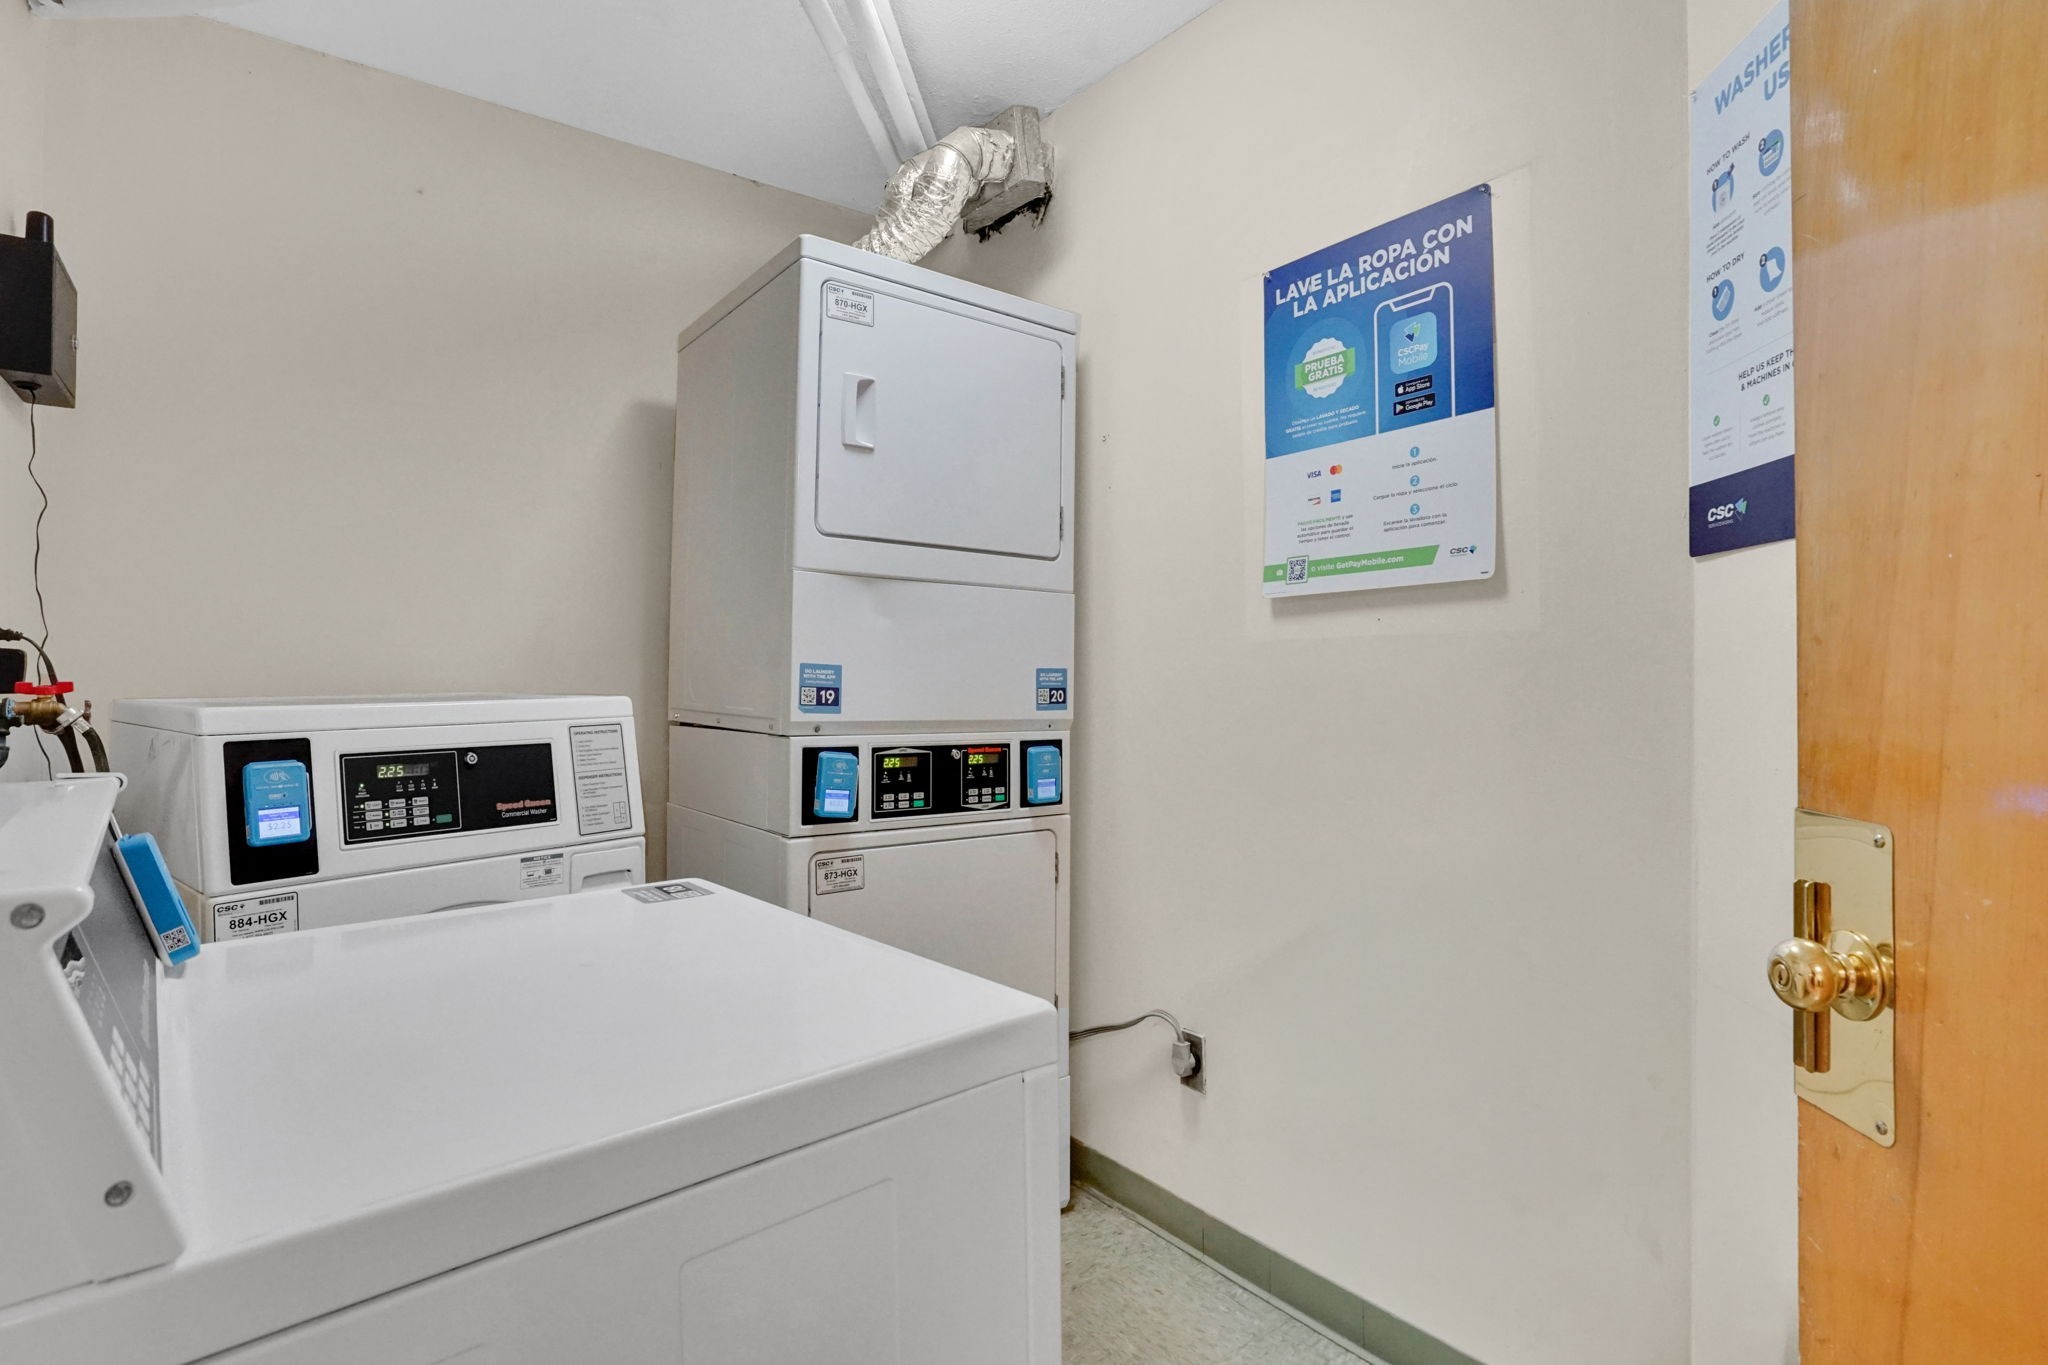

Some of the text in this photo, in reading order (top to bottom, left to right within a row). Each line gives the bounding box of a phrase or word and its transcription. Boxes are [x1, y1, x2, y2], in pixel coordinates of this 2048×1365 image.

[1706, 132, 1750, 175] HOW TO WASH
[1275, 214, 1473, 306] LAVE LA ROPA CON
[1706, 252, 1745, 283] HOW TO DRY
[1293, 245, 1450, 318] LA APLICACIÓN
[834, 298, 868, 313] 870-HGX
[1397, 343, 1429, 357] CSCPay
[1304, 353, 1345, 374] PRUEBA
[1398, 351, 1429, 367] Mobile
[1308, 364, 1344, 382] GRATIS
[1738, 366, 1755, 381] HELP
[1756, 361, 1765, 373] US
[1766, 352, 1784, 367] KEEP
[1740, 383, 1745, 391] &
[1746, 366, 1781, 388] MACHINES
[1782, 361, 1790, 372] IN
[1405, 381, 1431, 393] App Store
[1405, 398, 1434, 411] Google Play
[1316, 410, 1335, 420] LAVADO
[1307, 470, 1322, 479] VISA
[1372, 493, 1390, 501] Cargue
[1707, 503, 1735, 522] CSC
[1449, 546, 1469, 555] CSC
[1317, 564, 1335, 572] visite
[1335, 555, 1404, 570] GetPayMobile.com
[819, 689, 835, 704] 19
[1050, 690, 1064, 703] 20
[883, 757, 900, 769] 2.25
[968, 754, 984, 765] 2.25
[377, 765, 404, 779] 2.25
[501, 810, 530, 818] Commercial
[824, 869, 858, 881] 873-HGX
[217, 904, 239, 913] CSC
[229, 910, 288, 930] 884-HGX
